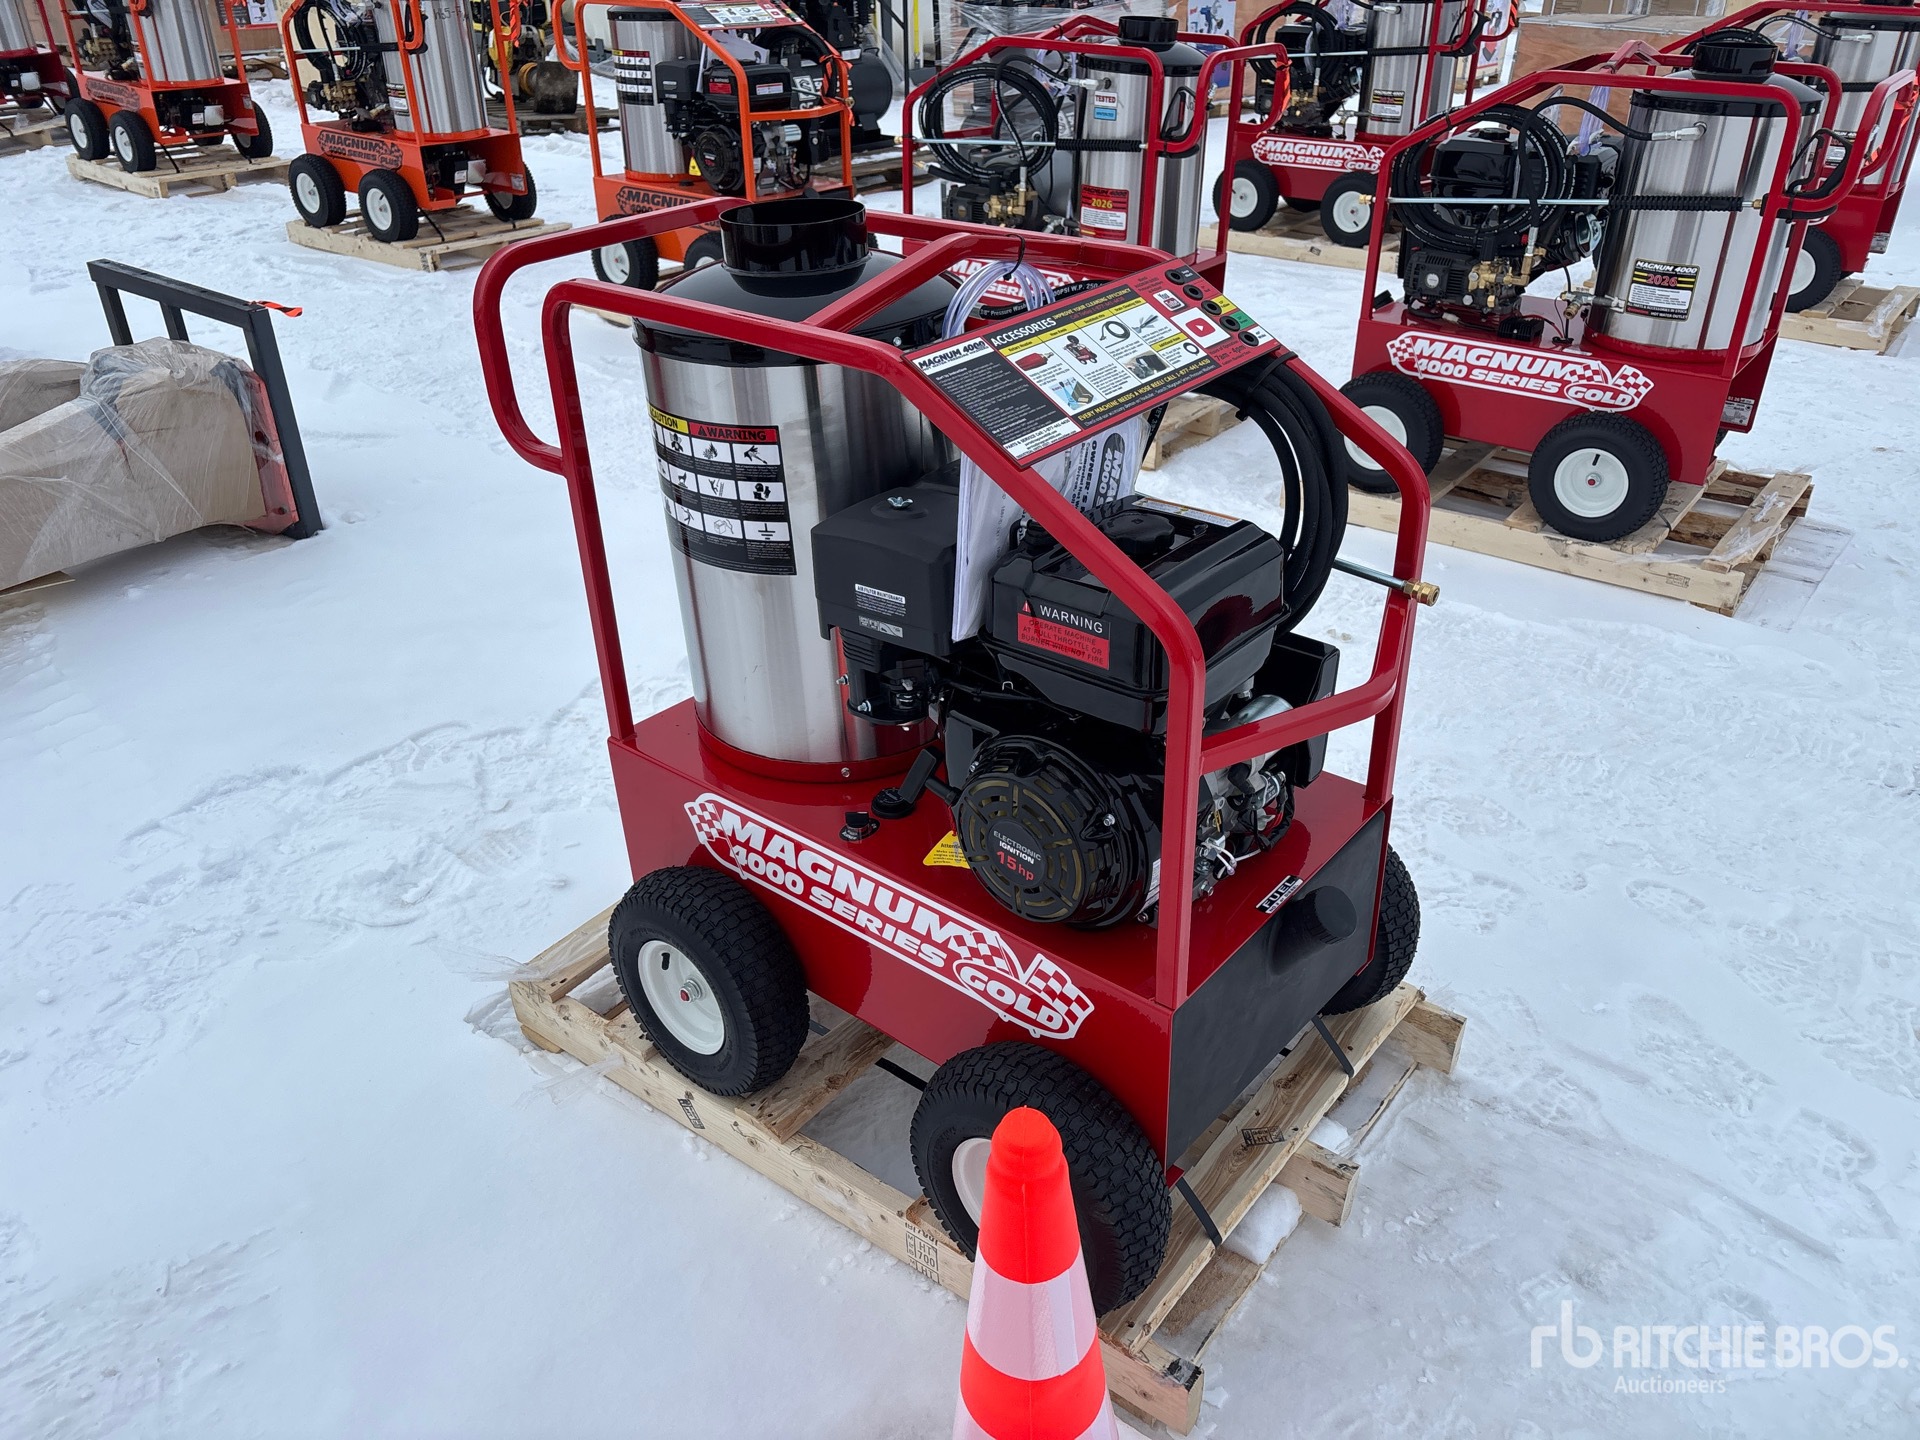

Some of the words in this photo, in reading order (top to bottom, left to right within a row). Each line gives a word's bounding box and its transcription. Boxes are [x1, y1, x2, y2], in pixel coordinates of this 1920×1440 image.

[325, 134, 380, 151] MAGNUM
[347, 149, 377, 161] SERIES
[1264, 140, 1348, 158] MAGNUM
[1267, 152, 1295, 163] 4000
[1296, 155, 1344, 167] SERIES
[1346, 161, 1379, 171] GOLD
[1091, 197, 1113, 209] 2026
[1636, 261, 1674, 272] MAGNUM
[1674, 266, 1698, 274] 4000
[1646, 273, 1678, 287] 2026
[990, 307, 1012, 317] Pressure
[1053, 309, 1073, 319] IMPROVE
[1085, 297, 1106, 307] CLEANING
[1106, 288, 1130, 299] EFFICIENCY
[989, 317, 1056, 346] ACCESSORIES
[917, 349, 961, 368] MAGNUM
[960, 340, 985, 353] 4000
[1214, 352, 1229, 361] 7am
[1415, 338, 1573, 380] MAGNUM
[1078, 411, 1095, 420] EVERY
[1095, 400, 1118, 413] MACHINE
[1118, 393, 1134, 402] NEEDS
[1138, 385, 1151, 393] HOSE
[1175, 358, 1210, 376] 1-877-441-4430
[1415, 358, 1467, 378] 4000
[1468, 368, 1562, 394] SERIES
[1567, 386, 1634, 407] GOLD
[652, 408, 679, 430] CAUTION
[705, 426, 767, 441] WARNING
[1020, 434, 1035, 442] SERVICE
[1078, 442, 1090, 486] Commercial
[1082, 440, 1098, 504] OWNER'S
[1099, 448, 1113, 494] 4000
[1029, 619, 1062, 634] OPERATE
[1064, 630, 1096, 646] MACHINE
[1040, 604, 1103, 634] WARNING
[1021, 633, 1050, 647] BURNER
[1052, 642, 1069, 652] WILL
[1070, 648, 1086, 658] NOT
[1087, 654, 1104, 665] FIRE
[1033, 628, 1051, 639] FULL
[1053, 634, 1089, 651] THROTTLE
[1091, 647, 1103, 656] OR
[993, 830, 1042, 861] ELECTRONIC
[999, 840, 1035, 865] IGNITION
[720, 808, 963, 948] MAGNUM
[730, 844, 805, 895] 4000
[808, 886, 947, 968] SERIES
[1262, 880, 1296, 908] FUEL
[958, 966, 1064, 1030] GOLD
[917, 1249, 936, 1268] 700
[919, 1241, 932, 1256] HT
